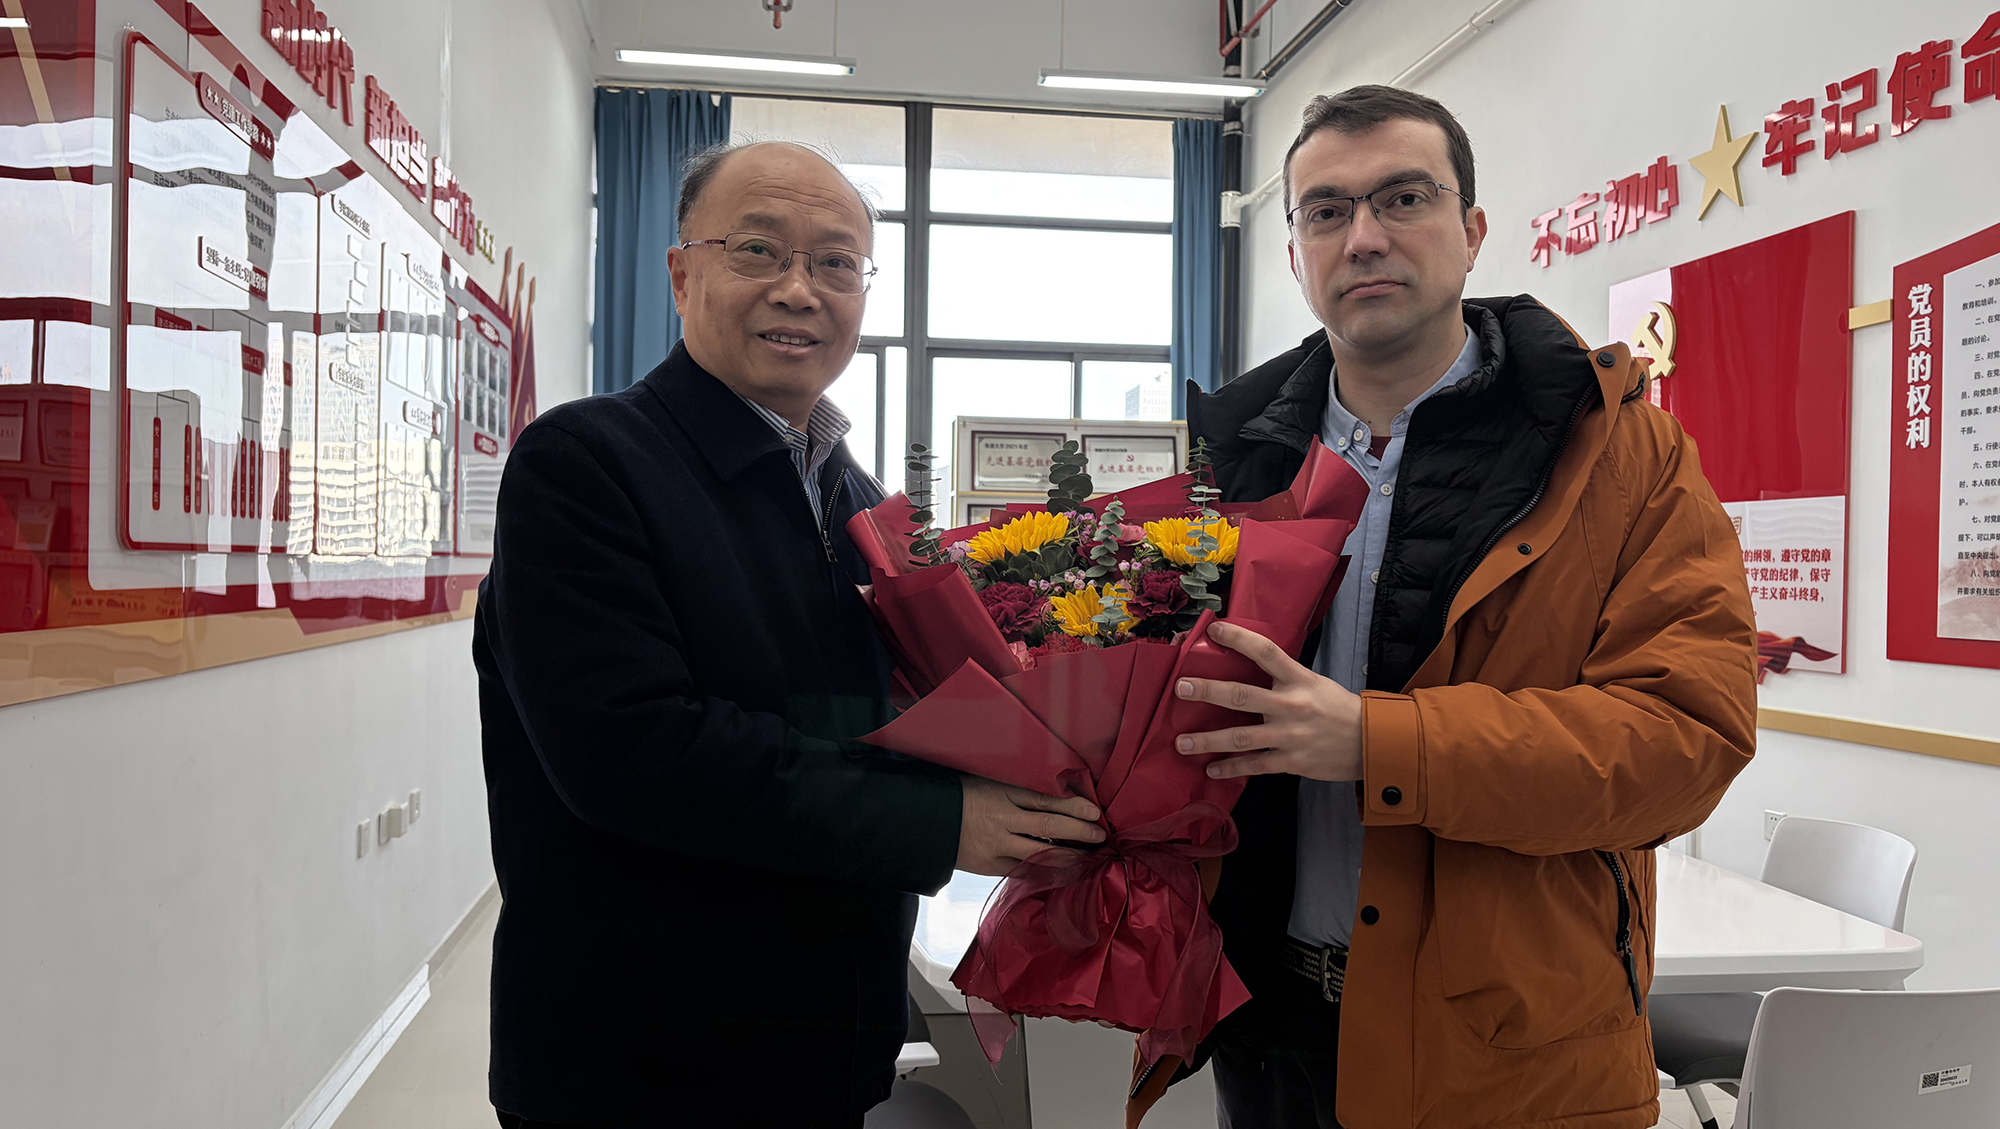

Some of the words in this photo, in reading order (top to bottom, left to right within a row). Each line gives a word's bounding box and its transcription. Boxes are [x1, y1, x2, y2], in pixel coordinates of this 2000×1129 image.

[1530, 155, 1679, 269] 不忘初心
[1762, 10, 2000, 176] 牢记使命
[1974, 350, 2000, 363] 三、对党
[1906, 284, 1932, 449] 党员的权利
[1974, 368, 2000, 381] 四、在党
[1961, 386, 2000, 400] 员，向党负责
[1960, 405, 2000, 418] 的事实，要求
[1973, 442, 2000, 453] 五、行使
[1742, 548, 1831, 564] 的纲领，遵守党的章
